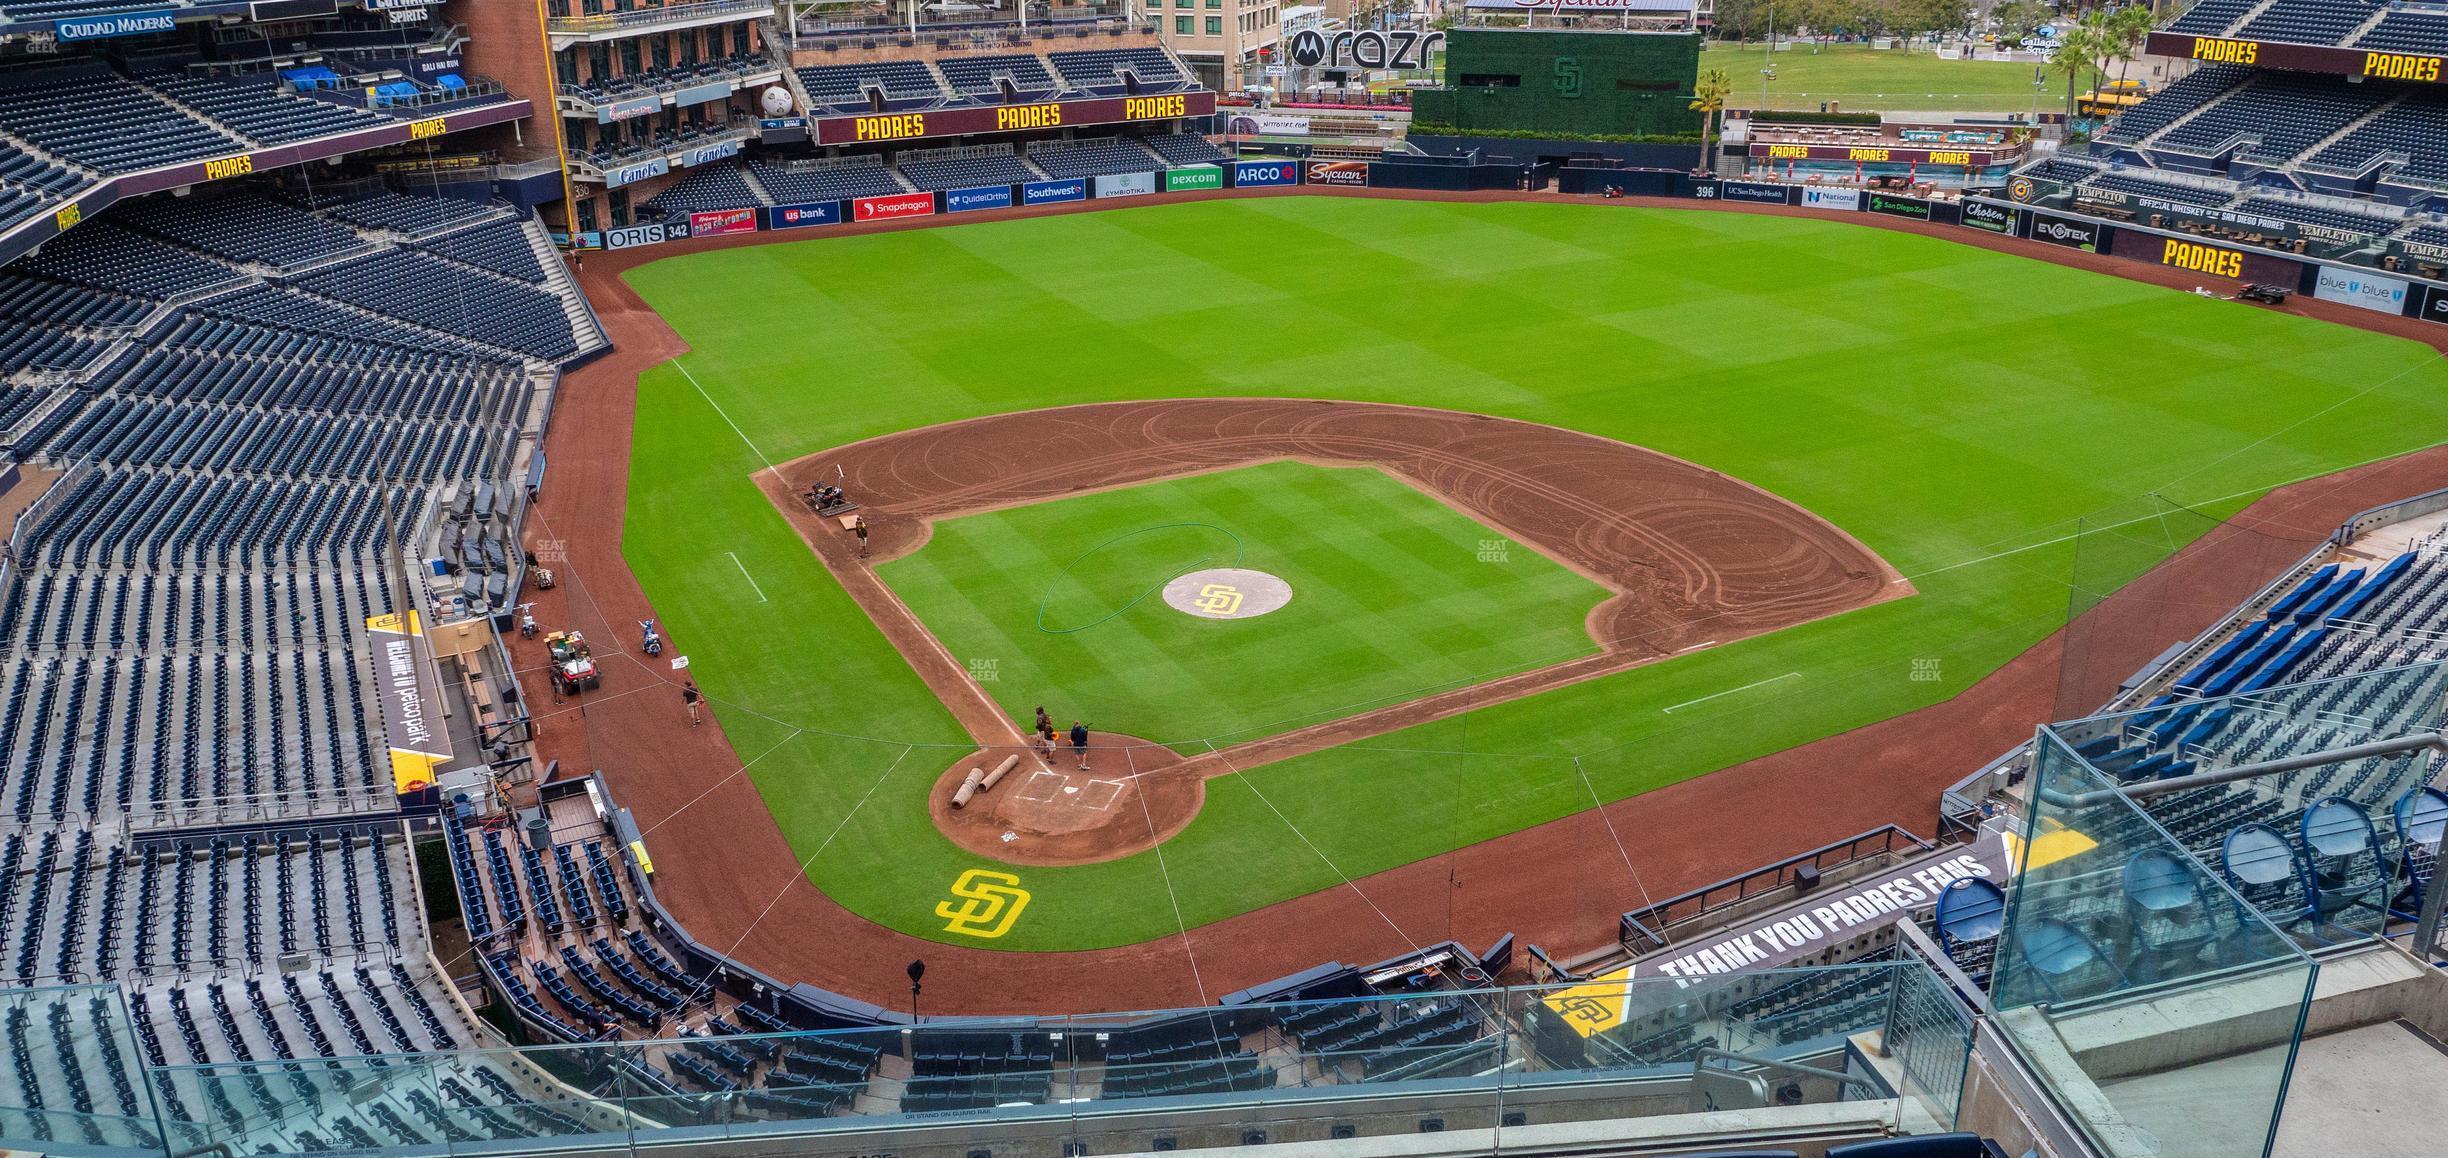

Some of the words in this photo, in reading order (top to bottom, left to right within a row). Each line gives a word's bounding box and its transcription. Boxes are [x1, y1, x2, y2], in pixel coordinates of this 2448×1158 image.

[390, 9, 428, 23] SPIRITS
[61, 22, 115, 39] CIUDAD
[118, 15, 174, 33] MADERAS
[1002, 40, 1032, 48] LANDING
[1328, 30, 1446, 70] razr
[2020, 37, 2061, 48] Gallagh
[2193, 37, 2257, 65] PADRES
[2364, 52, 2441, 82] PADRES
[997, 104, 1061, 130] PADRES
[1126, 95, 1185, 119] PADRES
[411, 117, 445, 139] PADRES
[856, 113, 924, 141] PADRES
[695, 143, 729, 164] Canel's
[1769, 145, 1807, 159] PADRES
[1850, 148, 1889, 161] PADRES
[1929, 152, 1970, 164] PADRES
[207, 155, 252, 181] PADRES
[619, 162, 658, 184] Canel's
[1238, 167, 1280, 181] ARCO
[1310, 162, 1361, 184] Sycuan
[574, 183, 589, 199] 336
[962, 192, 1008, 205] QuidelOrtho
[1027, 186, 1075, 199] Southwest
[1105, 187, 1145, 196] CYMBIOTIKA
[1696, 186, 1714, 198] 396
[1823, 192, 1856, 202] National
[2077, 187, 2128, 204] TEMPLETON
[57, 203, 81, 231] PADRES
[877, 199, 929, 214] Snapdragon
[1897, 203, 1914, 213] Diego
[1914, 206, 1928, 214] Zoo
[1966, 203, 2005, 220] Chosen
[2139, 198, 2170, 211] OFFICIAL
[2172, 203, 2205, 217] WHISKEY
[2221, 211, 2235, 222] SAN
[2236, 214, 2257, 226] DIEGO
[2257, 217, 2285, 231] PADRES
[610, 226, 662, 247] ORIS
[668, 224, 687, 238] 342
[2037, 223, 2091, 241] EVOTEK
[2298, 224, 2361, 244] TEMPLETON
[2162, 239, 2245, 278] PADRES
[2402, 242, 2448, 259] TEMPLE
[2320, 275, 2346, 290] blue
[2361, 283, 2390, 298] blue
[1194, 582, 1243, 616] SD
[394, 688, 425, 719] petco
[400, 718, 432, 746] park
[934, 868, 1032, 939] SD
[1657, 933, 1770, 989] THANK
[1754, 912, 1825, 954] YOU
[1811, 877, 1928, 934] PADRES
[1912, 854, 1992, 895] FANS
